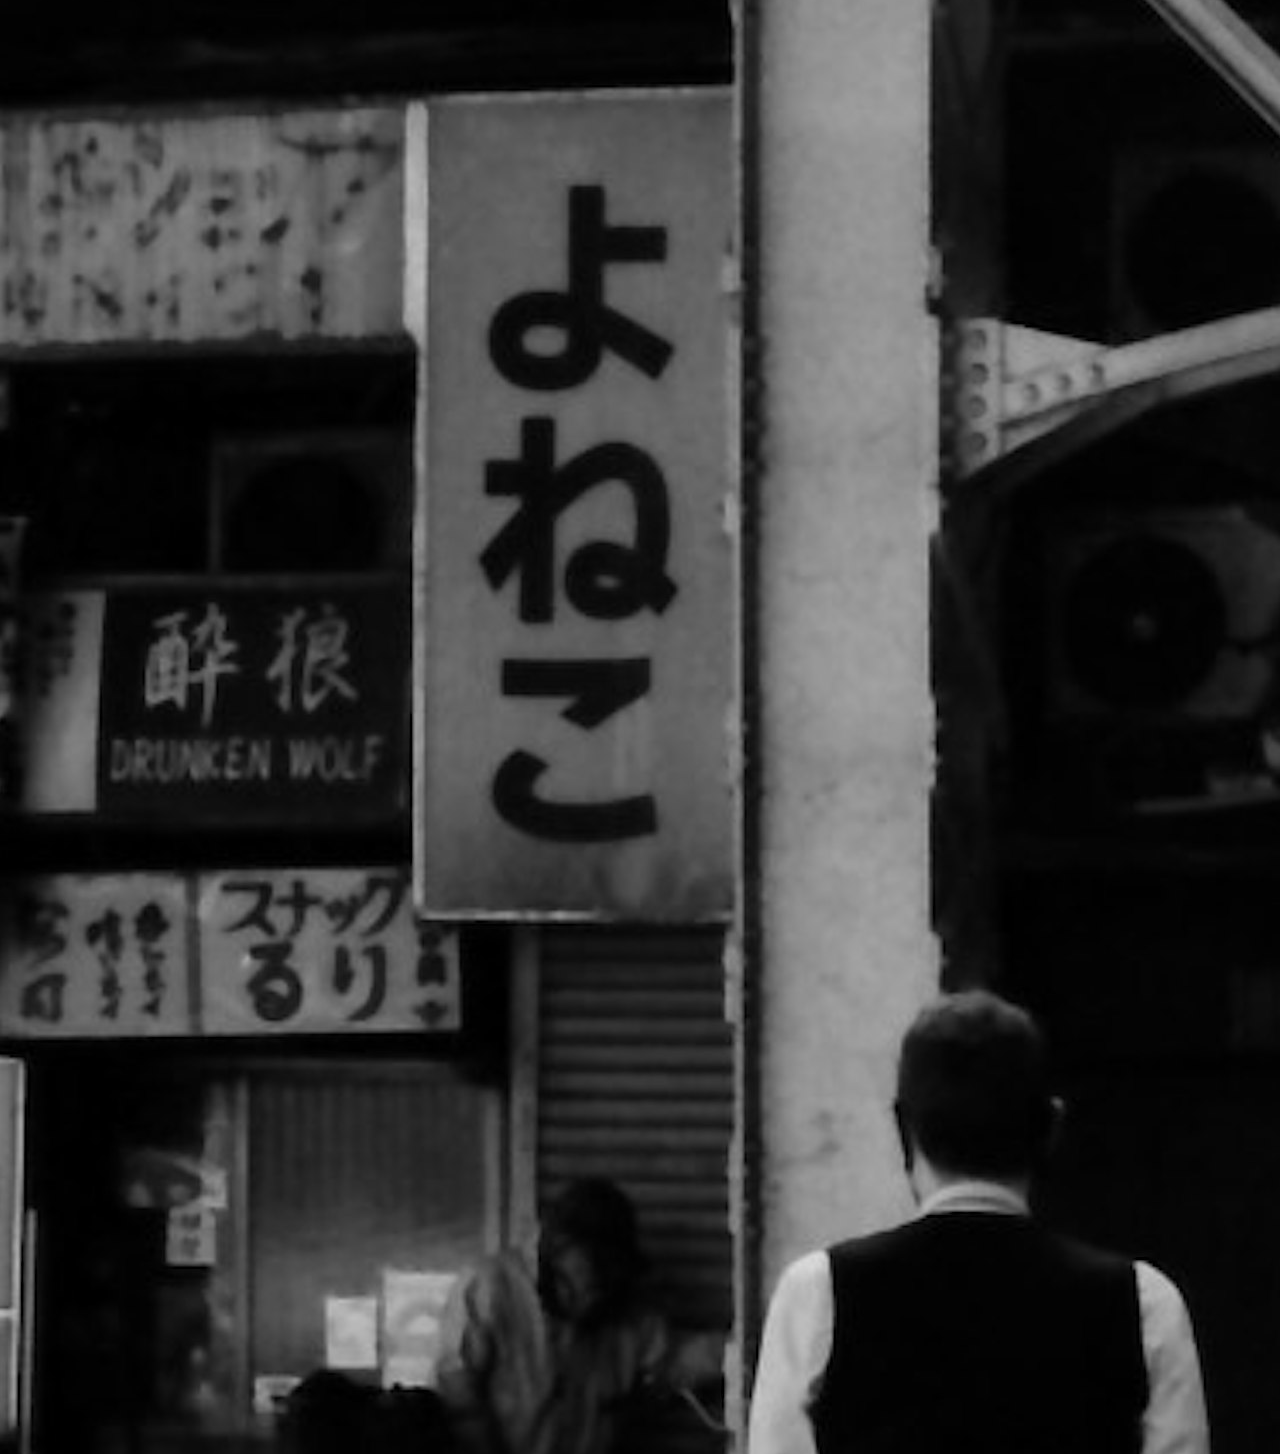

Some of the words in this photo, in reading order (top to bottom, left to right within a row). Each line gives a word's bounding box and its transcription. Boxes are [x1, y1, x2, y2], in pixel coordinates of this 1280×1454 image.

[478, 186, 680, 844] よねこ
[110, 736, 270, 782] DRUNKEN
[288, 734, 382, 782] WOLF
[220, 877, 408, 937] スナック
[247, 943, 388, 1022] るり
